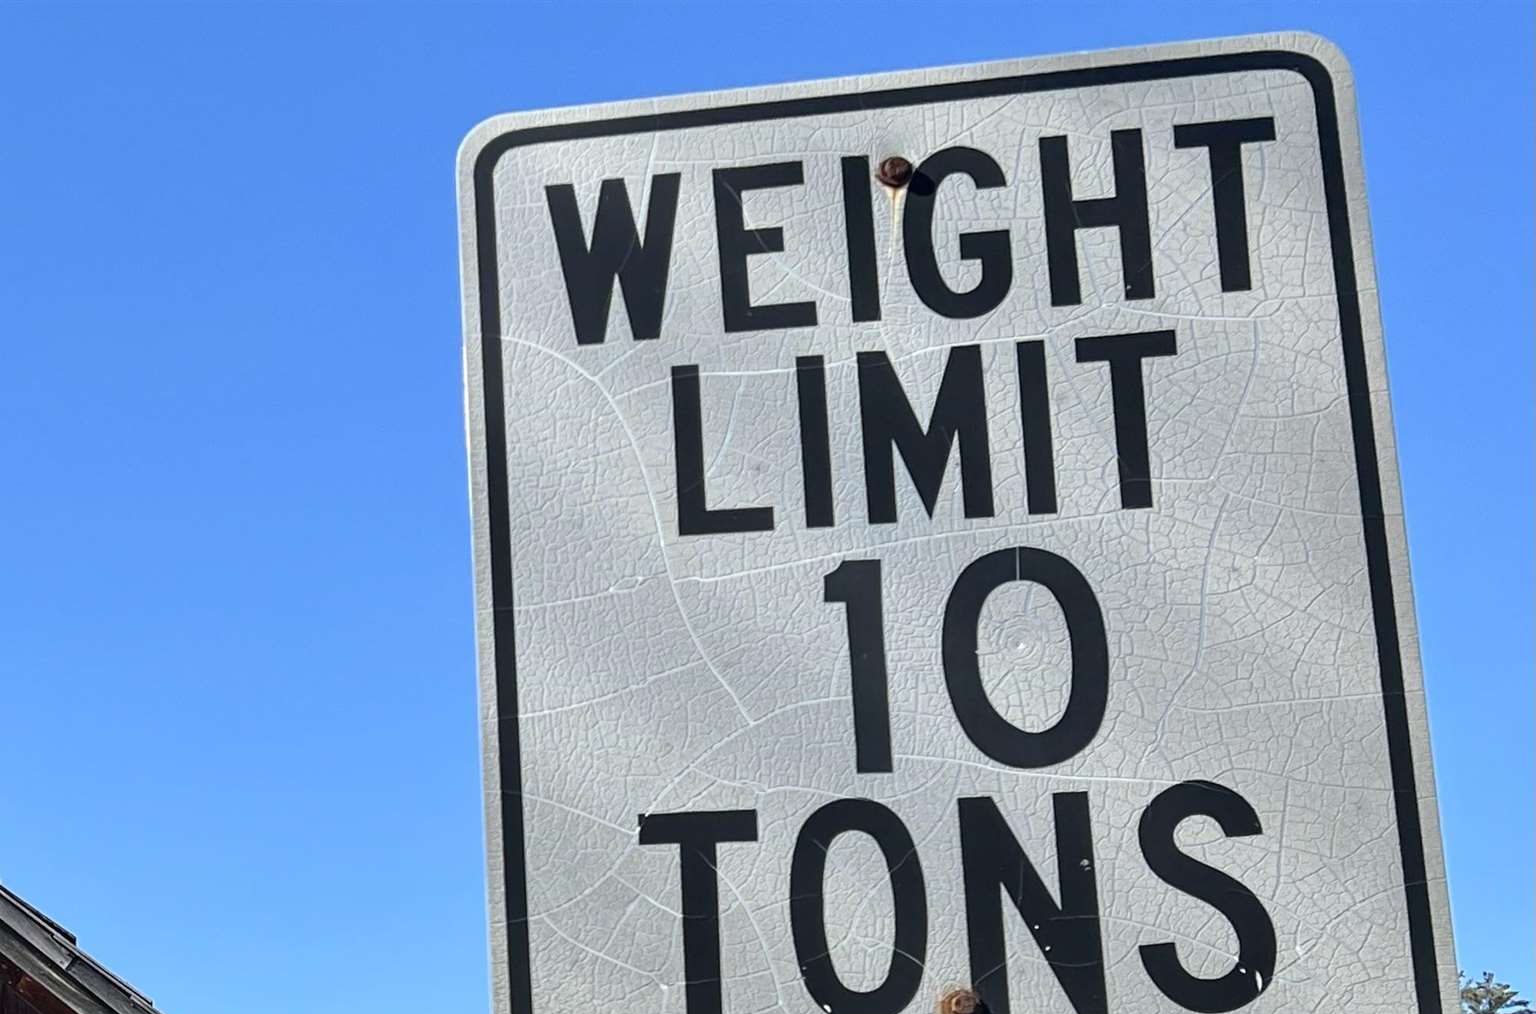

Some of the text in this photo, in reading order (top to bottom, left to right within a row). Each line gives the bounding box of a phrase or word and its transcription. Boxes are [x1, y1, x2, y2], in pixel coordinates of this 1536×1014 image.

[545, 116, 1277, 345] WEIGHT
[671, 329, 1178, 537] LIMIT
[823, 546, 1109, 774] 10
